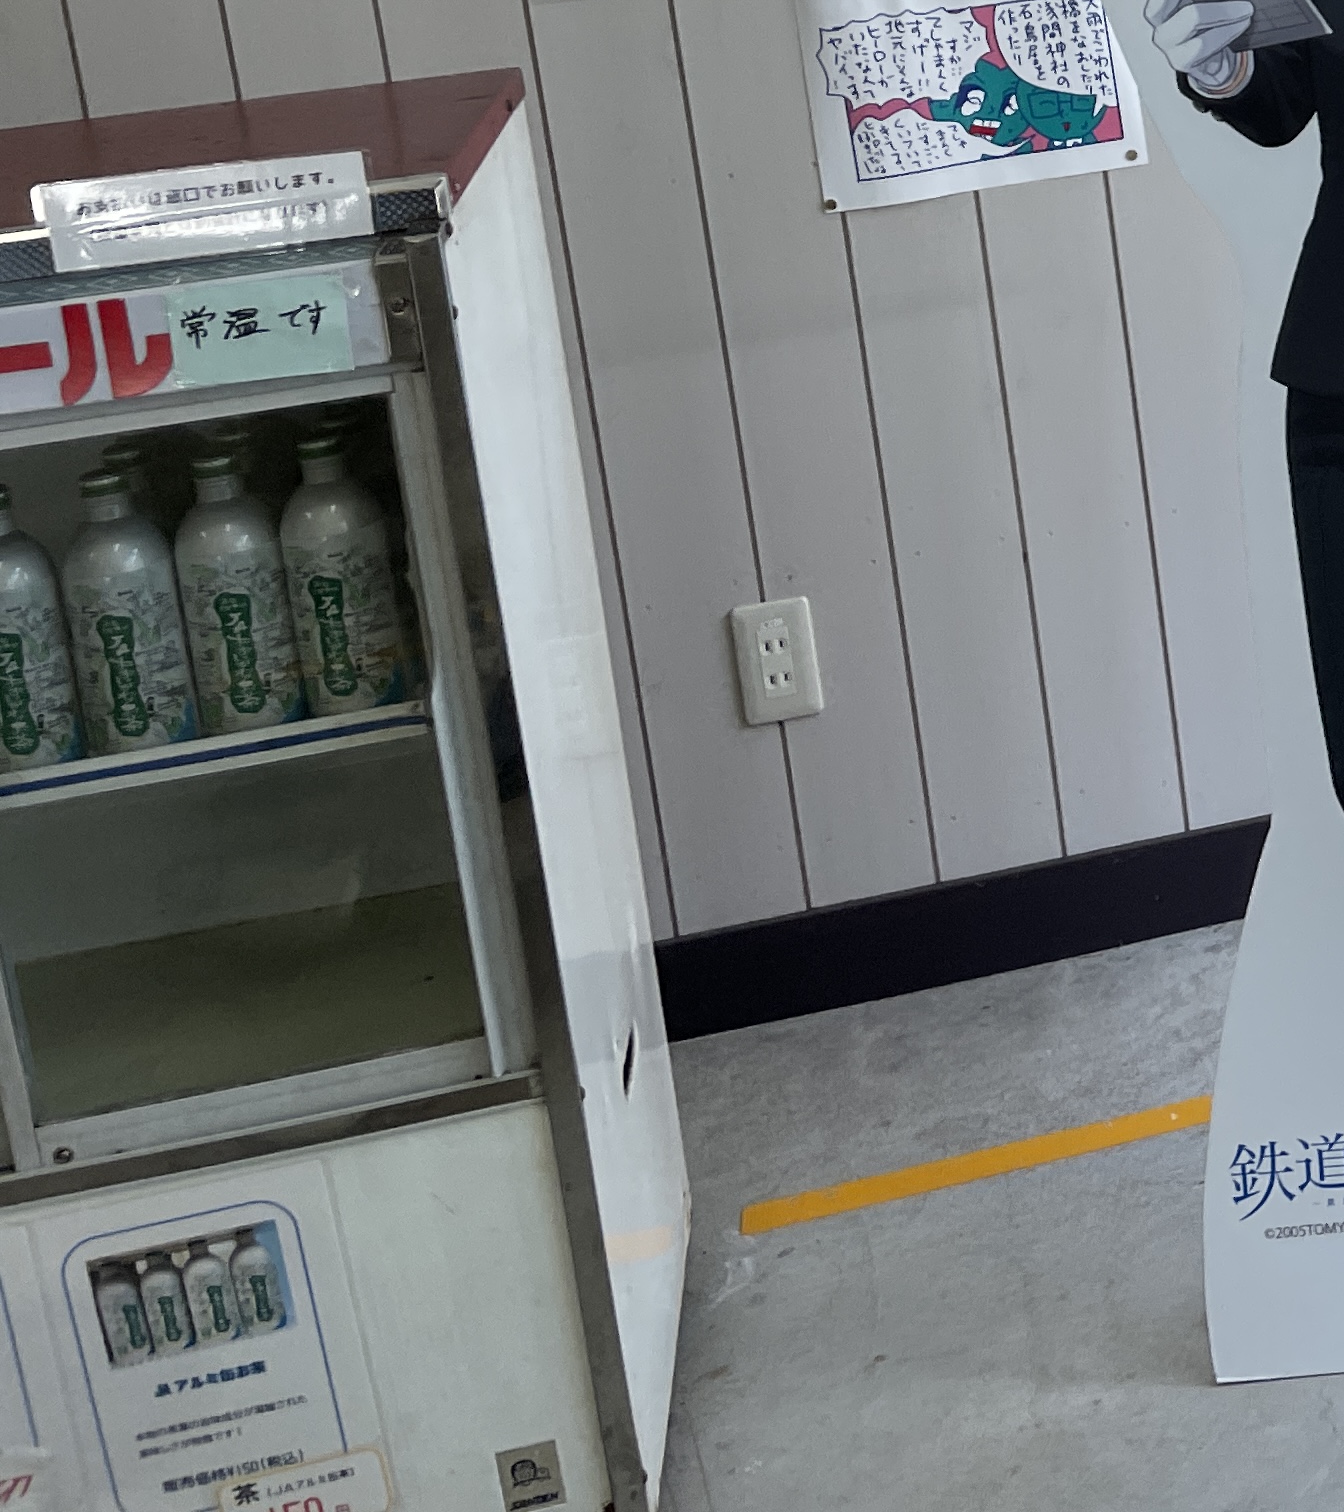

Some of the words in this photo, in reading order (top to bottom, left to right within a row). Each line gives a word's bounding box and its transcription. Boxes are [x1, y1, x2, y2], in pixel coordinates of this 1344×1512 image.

[180, 300, 327, 350] 常温です
[232, 1483, 260, 1506] 茶
